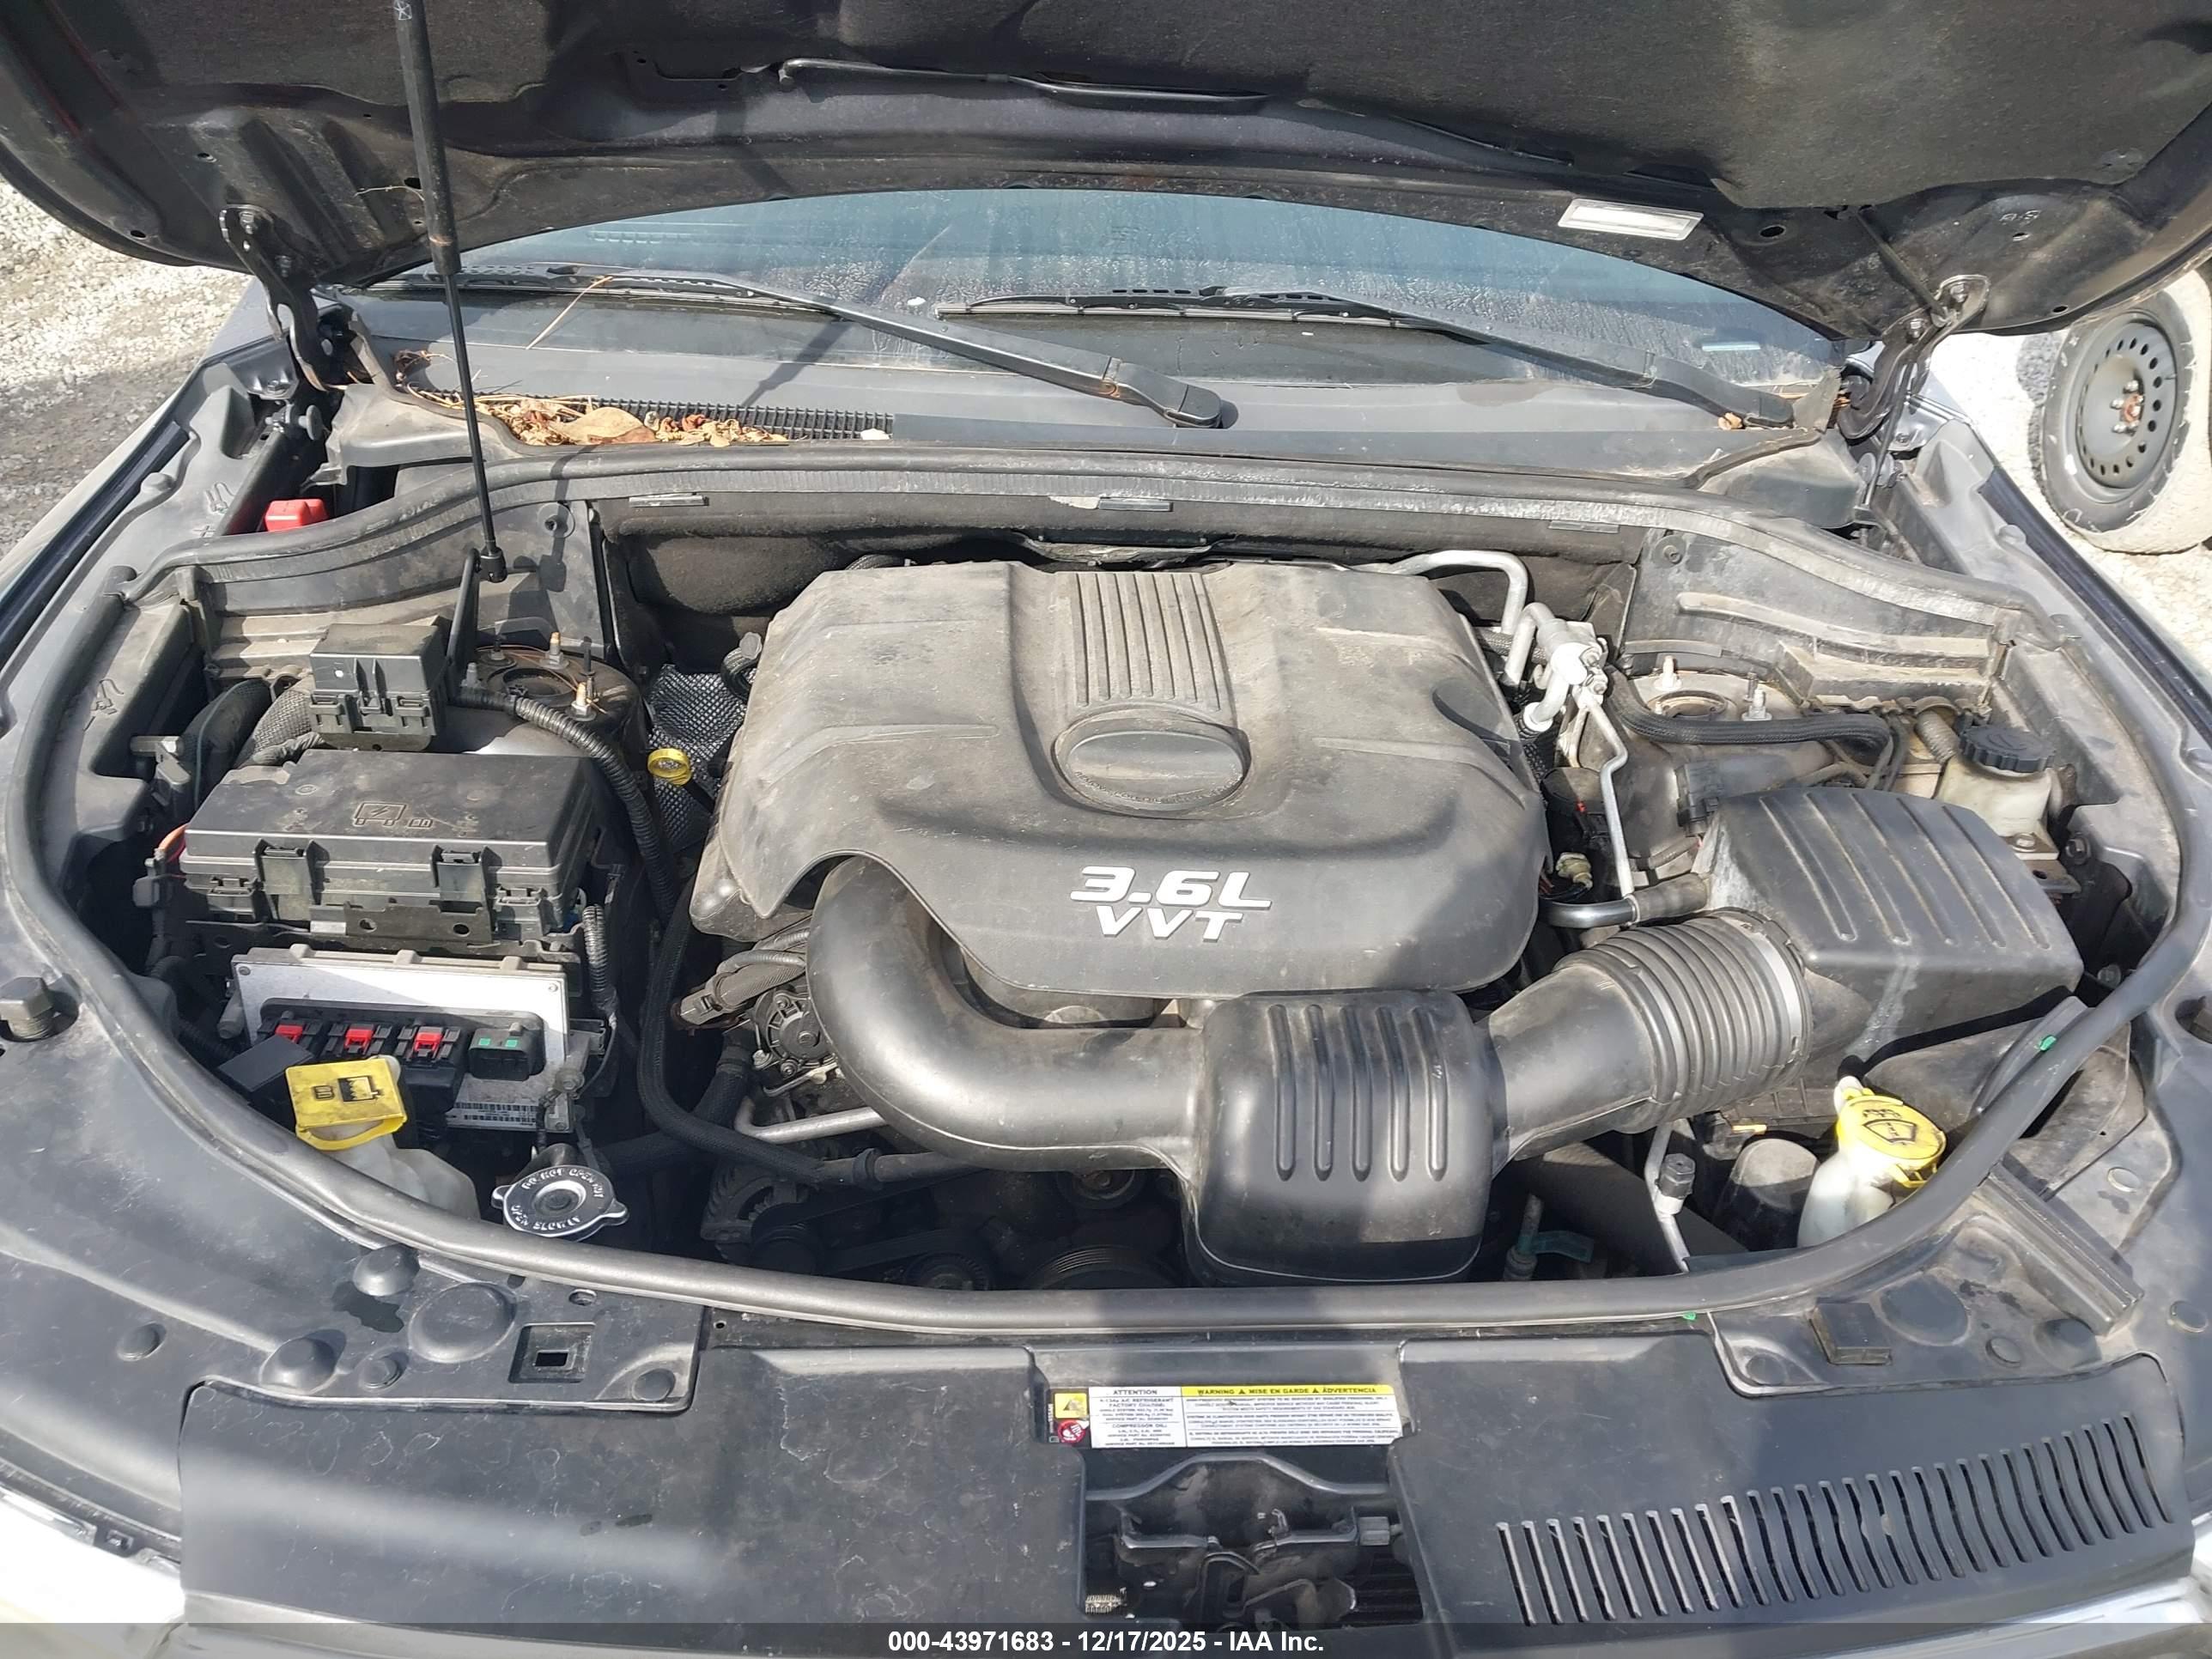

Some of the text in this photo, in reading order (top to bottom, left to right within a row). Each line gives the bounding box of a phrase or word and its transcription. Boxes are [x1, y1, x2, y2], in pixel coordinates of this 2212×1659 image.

[1070, 866, 1273, 910] 3.6L
[1095, 905, 1244, 943] VVT
[521, 1177, 538, 1189] DO
[540, 1168, 564, 1181] NOT
[568, 1168, 596, 1183] OPEN
[511, 1205, 580, 1231] OPEN SLOWLY
